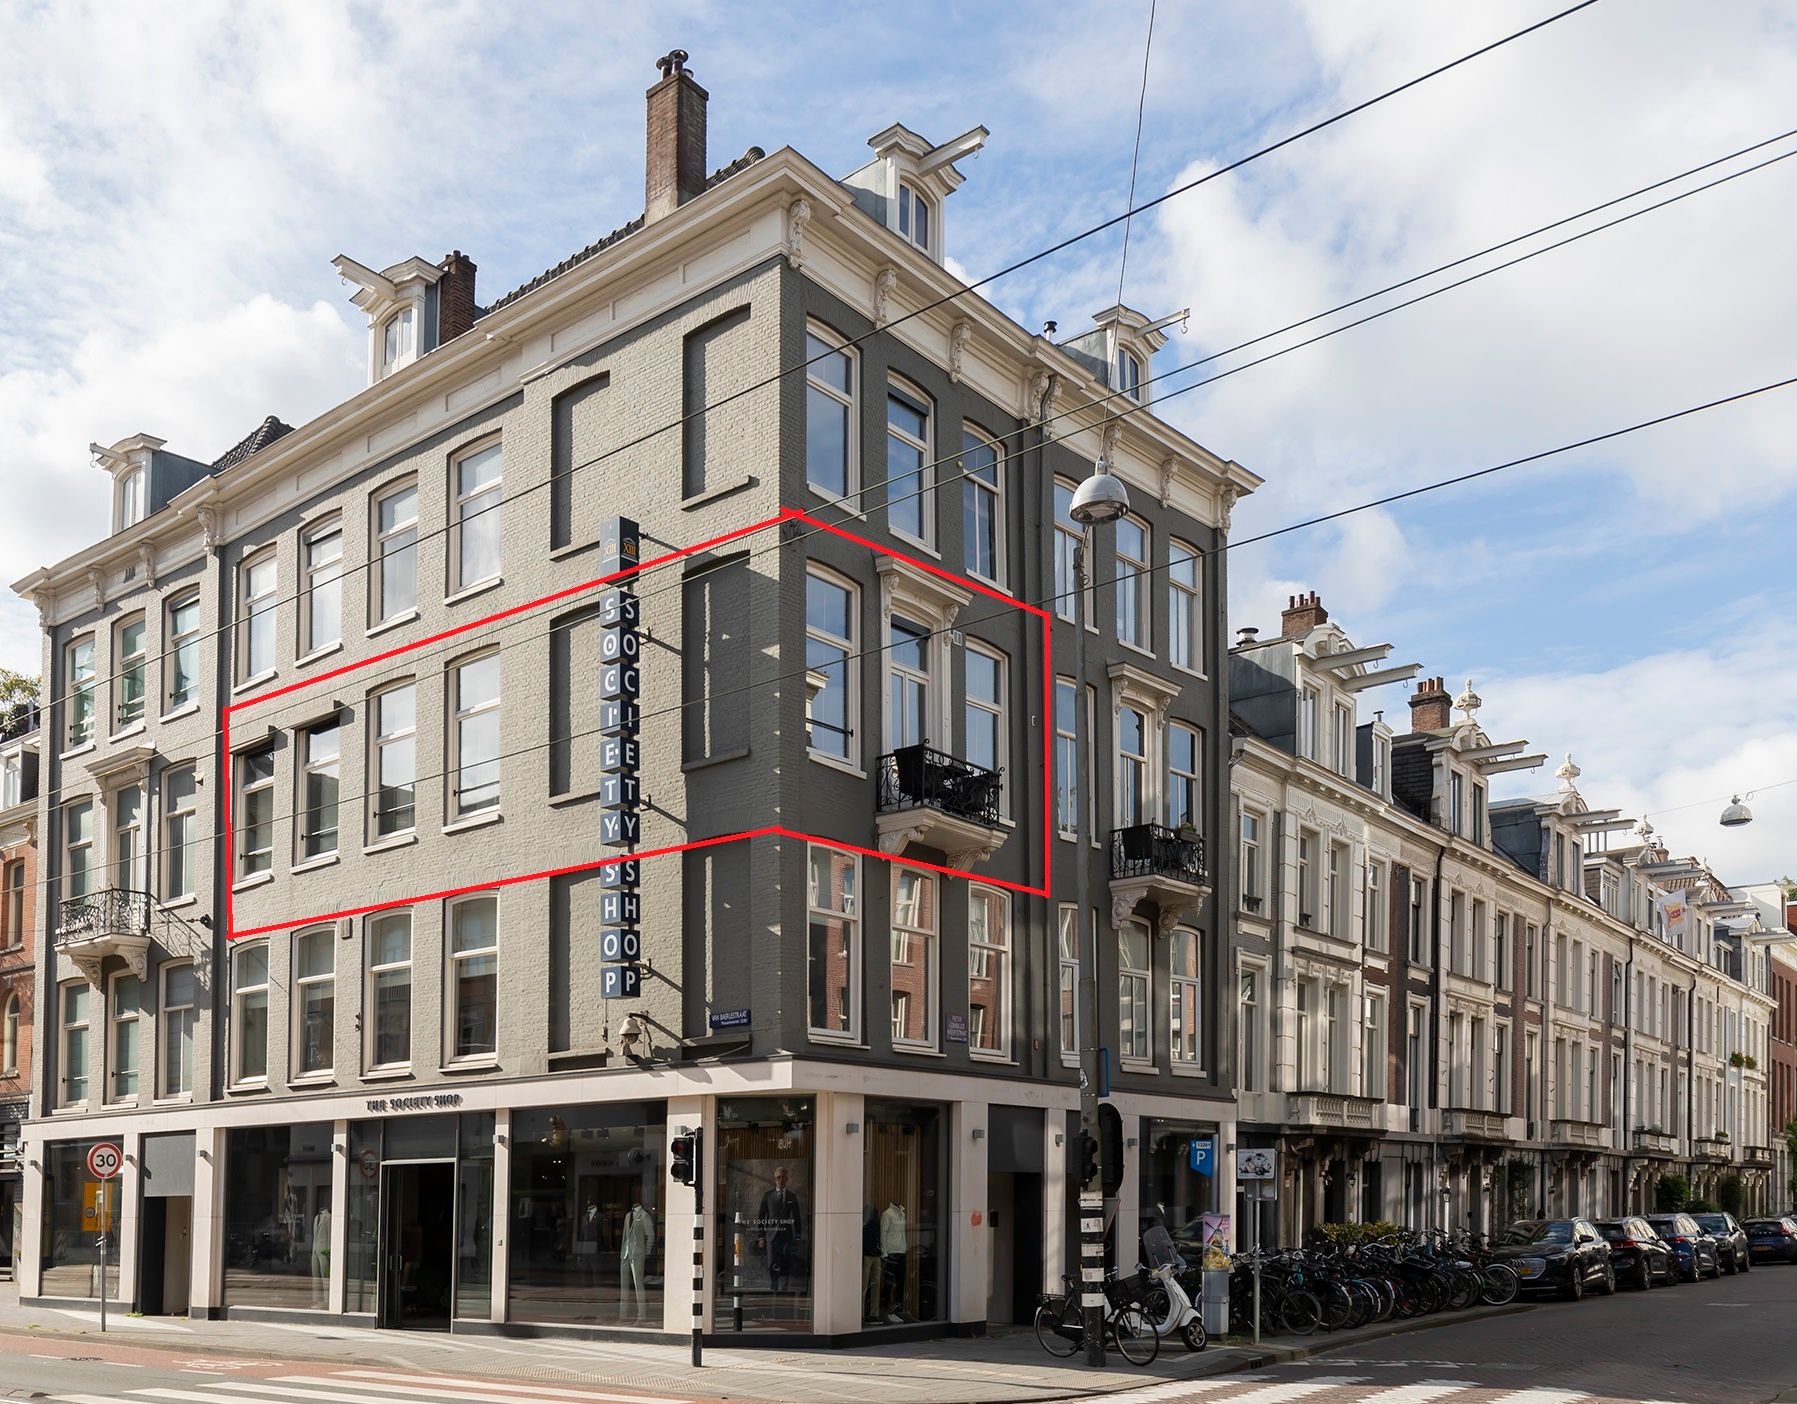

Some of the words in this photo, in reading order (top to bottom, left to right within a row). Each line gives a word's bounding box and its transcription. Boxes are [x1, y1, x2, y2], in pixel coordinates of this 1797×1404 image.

[603, 597, 618, 838] SOCIETY
[622, 597, 637, 838] SOCIETY
[603, 861, 618, 993] SHOP
[622, 860, 637, 992] SHOP
[95, 1154, 117, 1168] 30
[366, 1099, 388, 1113] THE
[389, 1096, 433, 1111] SOCIETY
[434, 1093, 463, 1108] SHOP
[1196, 1150, 1206, 1165] P
